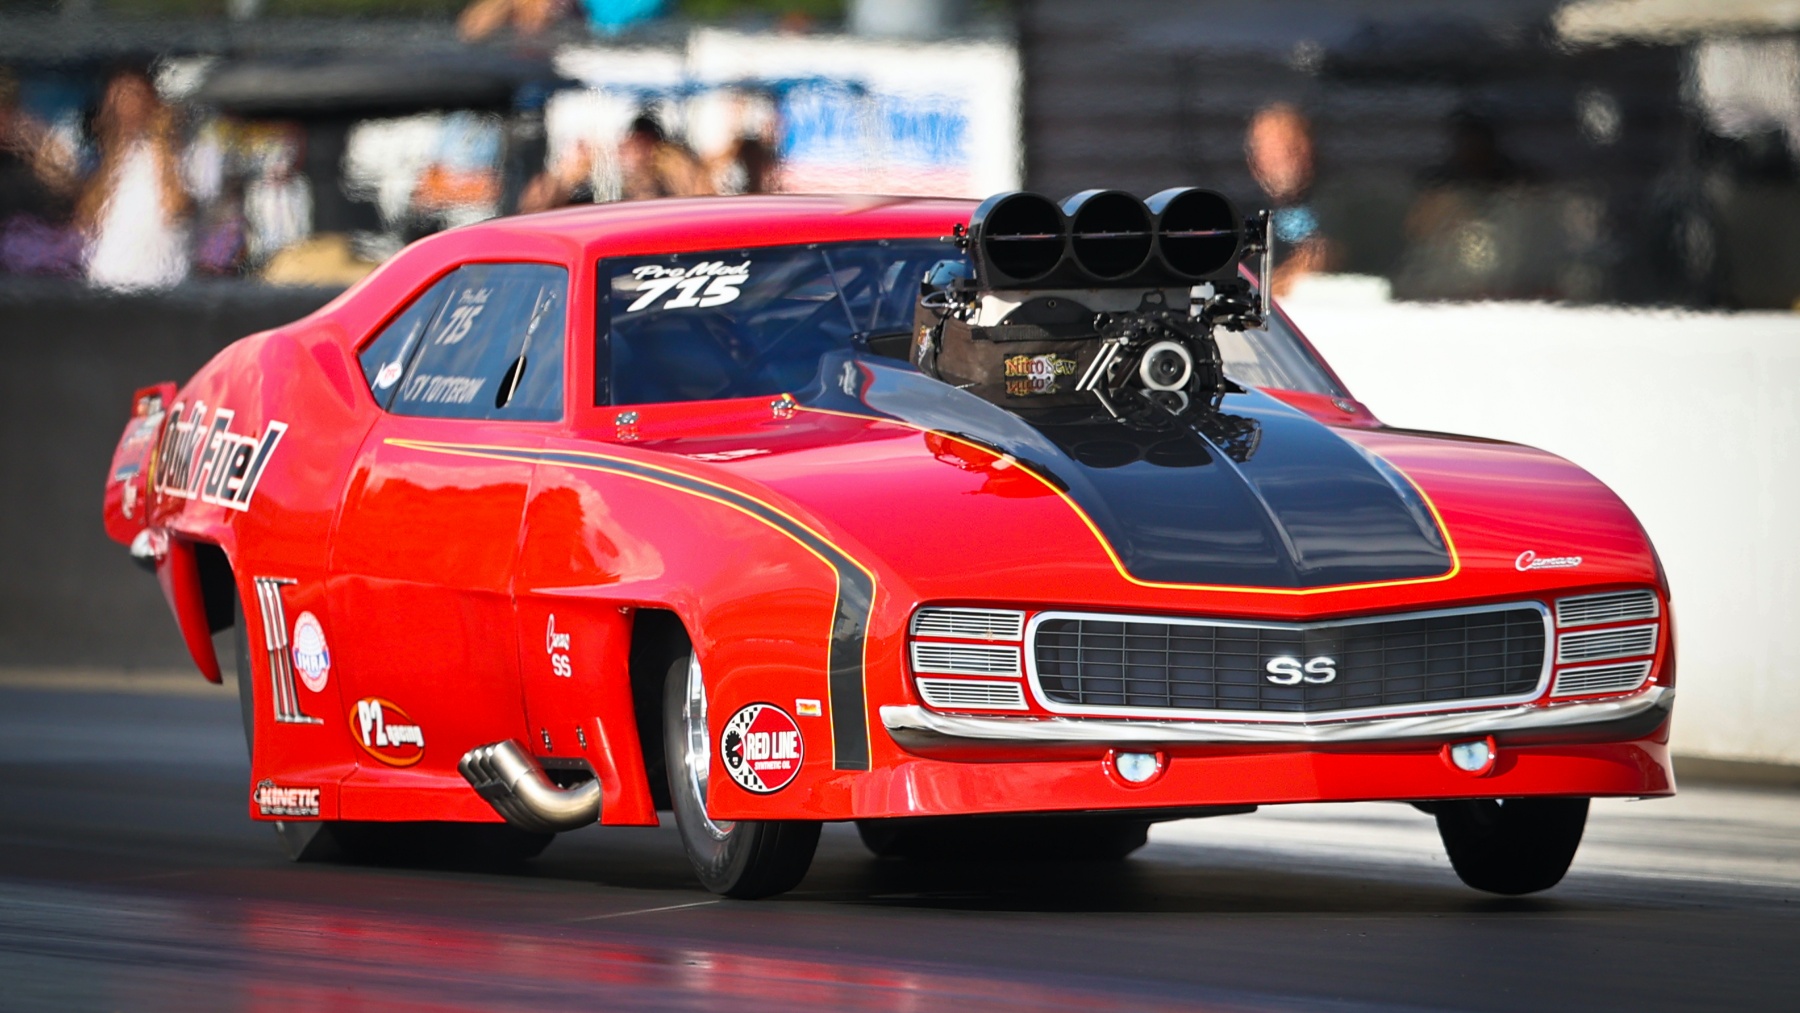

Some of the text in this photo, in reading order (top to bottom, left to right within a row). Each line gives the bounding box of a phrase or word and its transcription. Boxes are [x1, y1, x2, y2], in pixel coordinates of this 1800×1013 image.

[632, 260, 752, 280] Pro Mod
[626, 274, 750, 312] 715
[434, 304, 485, 345] 715
[1005, 353, 1077, 376] Nitro Sew
[186, 407, 288, 512] Fuel
[1515, 549, 1583, 572] Camaro
[551, 653, 572, 678] SS
[1266, 656, 1337, 685] SS
[357, 699, 389, 747] P2
[746, 730, 800, 760] RED LINE
[260, 786, 320, 807] KINETIC
